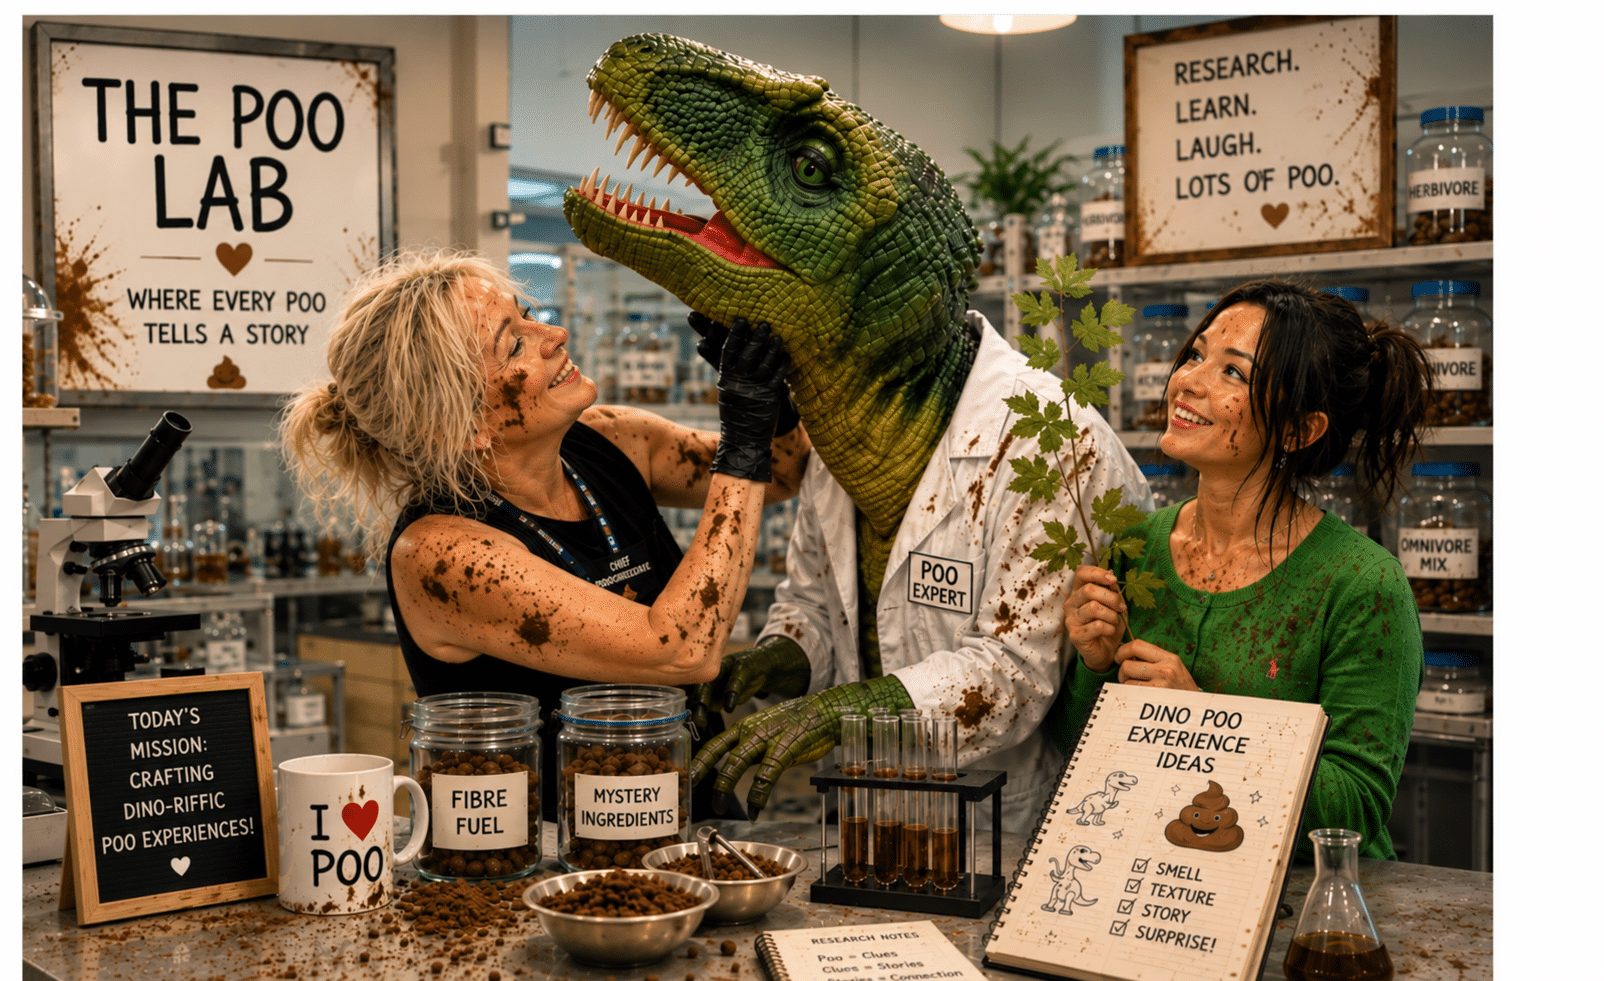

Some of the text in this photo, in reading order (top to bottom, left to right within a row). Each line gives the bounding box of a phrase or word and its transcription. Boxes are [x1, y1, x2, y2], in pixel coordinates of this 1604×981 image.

[1174, 49, 1300, 85] RESEARCH.
[82, 77, 345, 152] THE POO
[1175, 94, 1257, 124] LEARN.
[1175, 132, 1262, 162] LAUGH.
[155, 154, 293, 232] LAB
[1175, 163, 1340, 200] LOTS OF POO.
[1408, 181, 1479, 199] HERBIVORE
[127, 288, 326, 313] WHERE EVERY POO
[144, 323, 309, 345] TELLS A STORY
[1401, 538, 1472, 553] OMNIVORE
[610, 555, 630, 571] CHIEF
[922, 561, 958, 585] POO
[1420, 558, 1447, 571] MIX
[913, 582, 966, 607] EXPERT
[128, 707, 201, 730] TODAY'S
[1139, 703, 1242, 729] DINO POO
[130, 736, 208, 760] MISSION:
[1127, 726, 1250, 754] EXPERIENCE
[1156, 752, 1215, 774] IDEAS
[129, 764, 214, 789] CRAFTING
[123, 792, 226, 820] DINO-RIFFIC
[451, 789, 508, 809] FIBRE
[594, 787, 661, 804] MYSTERY
[310, 804, 330, 841] I
[456, 817, 504, 835] FUEL
[581, 809, 674, 828] INGREDIENTS
[102, 817, 255, 854] POO EXPERIENCES!
[310, 846, 384, 887] POO
[1156, 862, 1202, 882] SMELL
[1151, 882, 1216, 906] TEXTURE
[1141, 904, 1191, 923] STORY
[811, 932, 920, 945] RESEARCH NOTES
[1135, 925, 1217, 953] SURPRISE!
[877, 961, 924, 970] Stories
[890, 970, 963, 981] Connection
